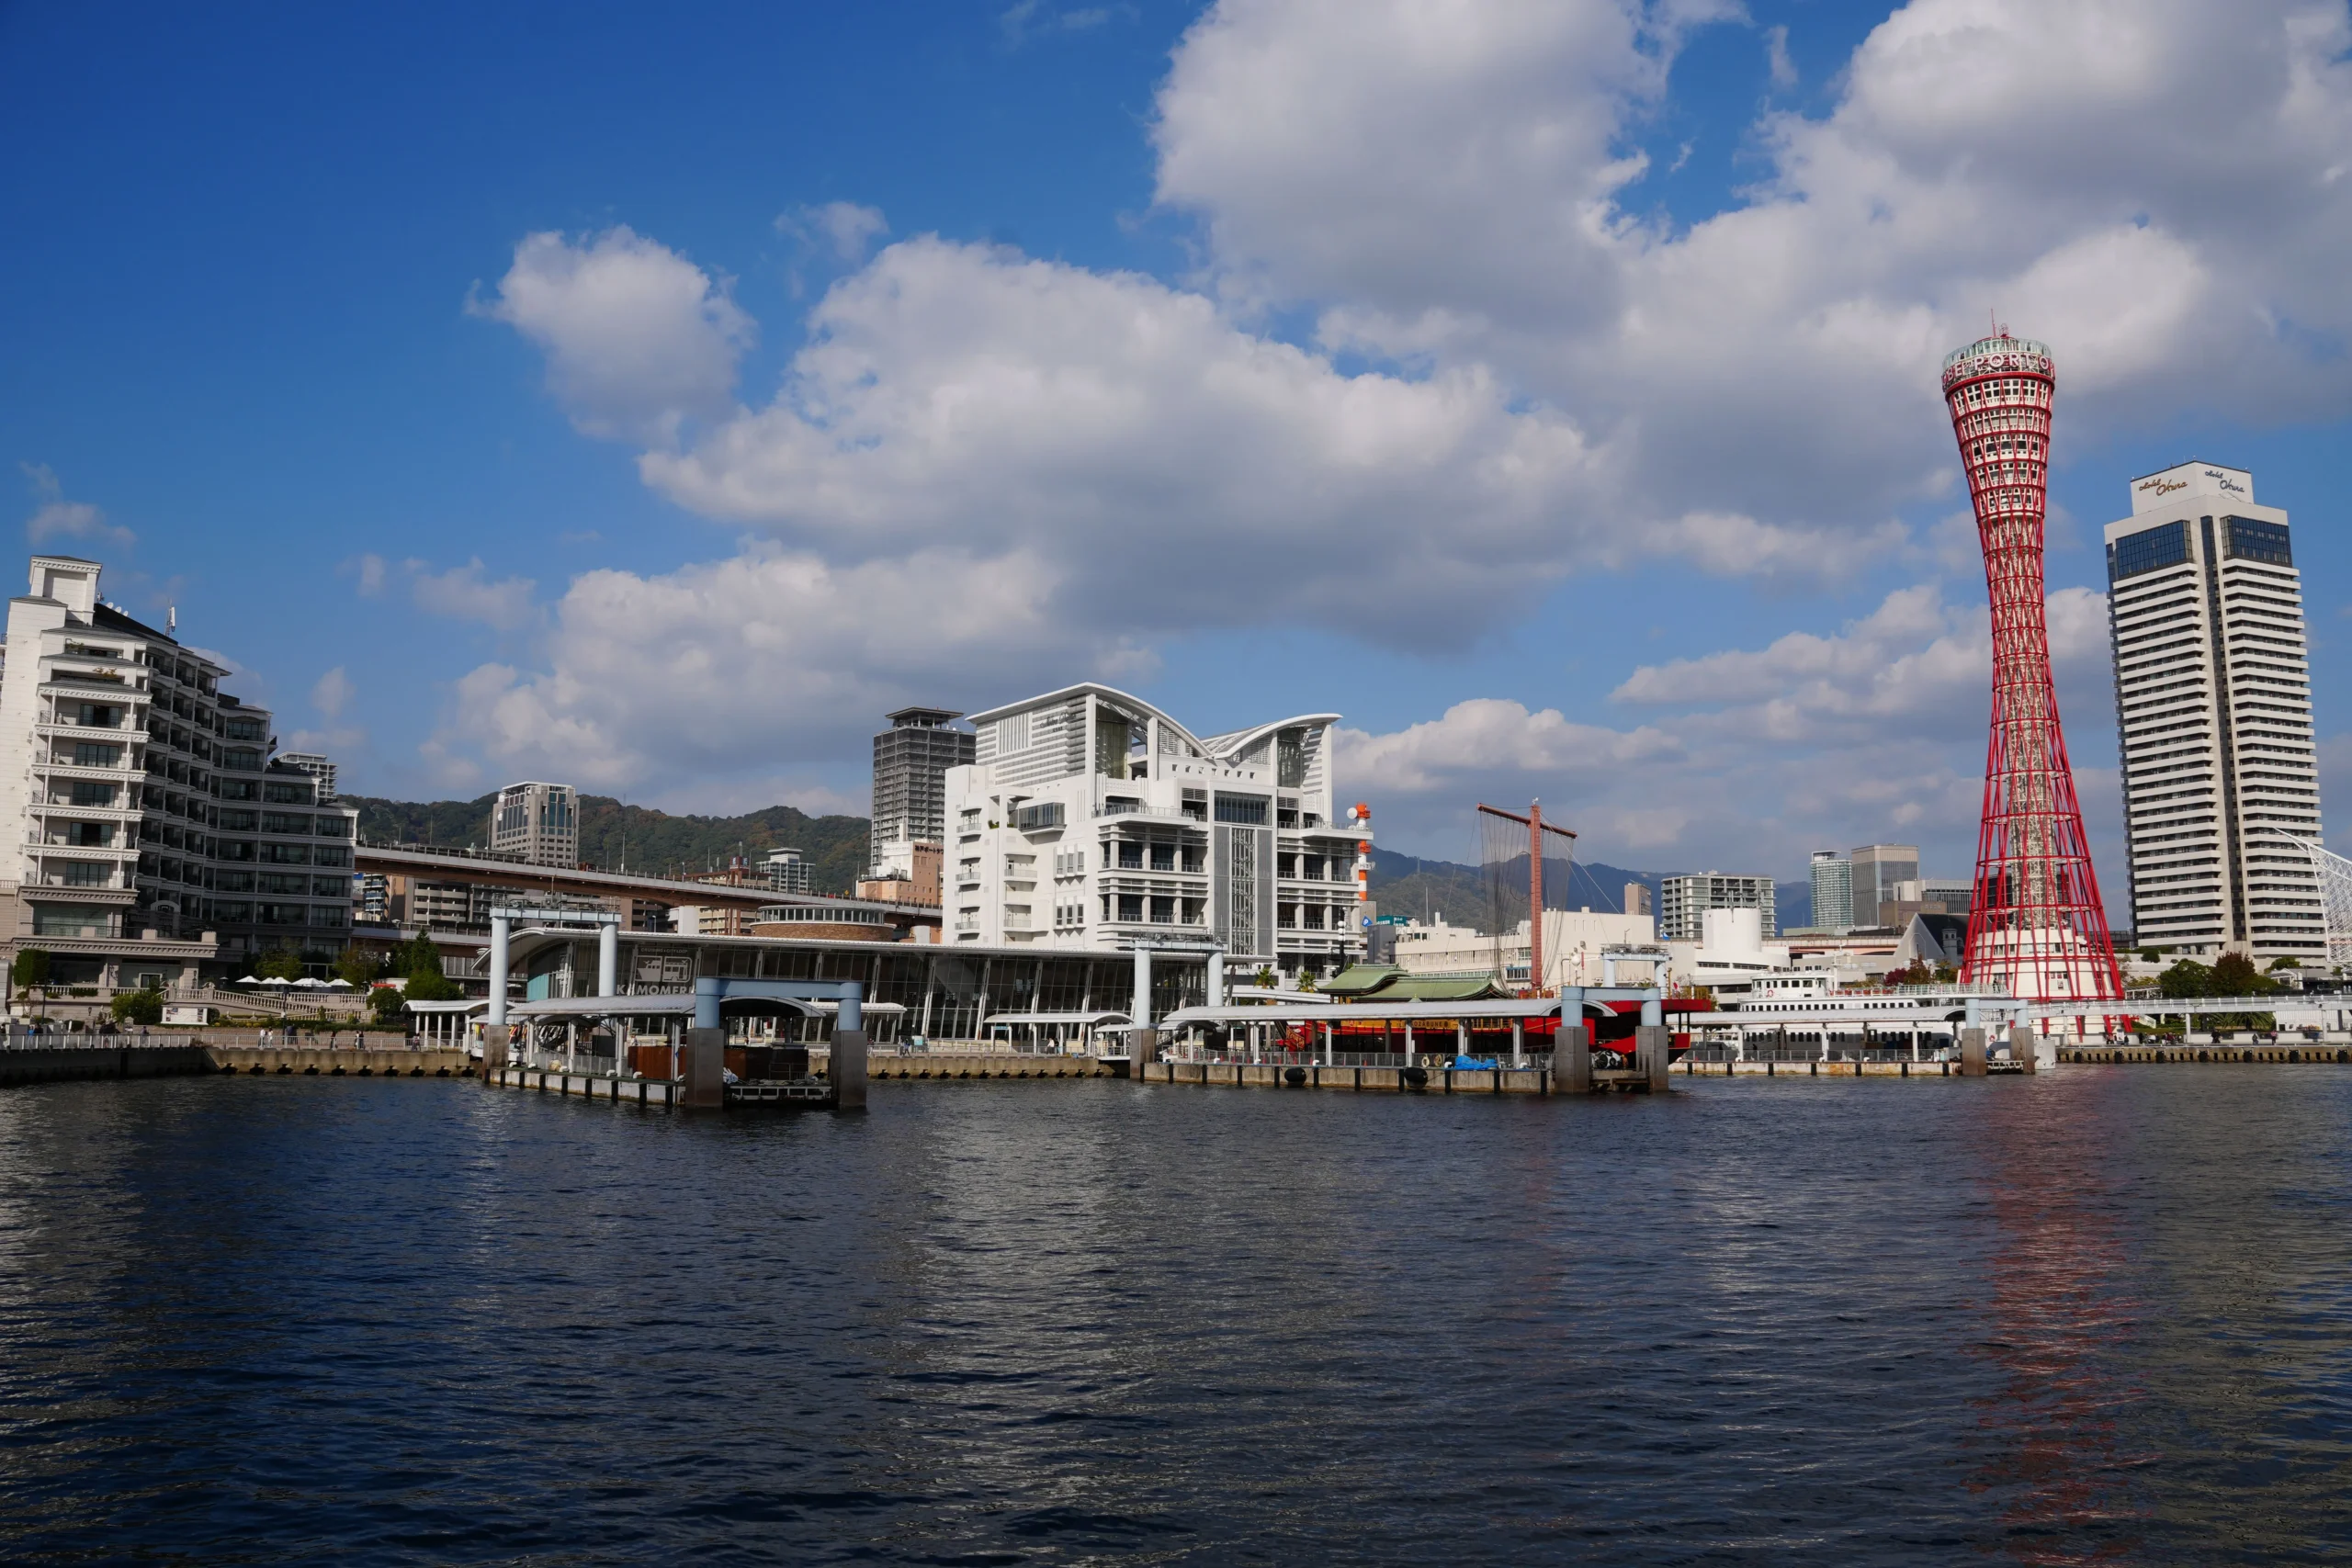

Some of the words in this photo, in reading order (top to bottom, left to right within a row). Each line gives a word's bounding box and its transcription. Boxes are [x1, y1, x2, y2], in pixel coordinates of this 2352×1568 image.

[1974, 353, 2031, 370] PORT
[2139, 479, 2161, 491] Hotel
[2156, 479, 2188, 496] Okura
[2205, 470, 2223, 479] Hotel
[2220, 479, 2245, 492] Okura
[616, 984, 695, 996] KMOMERI
